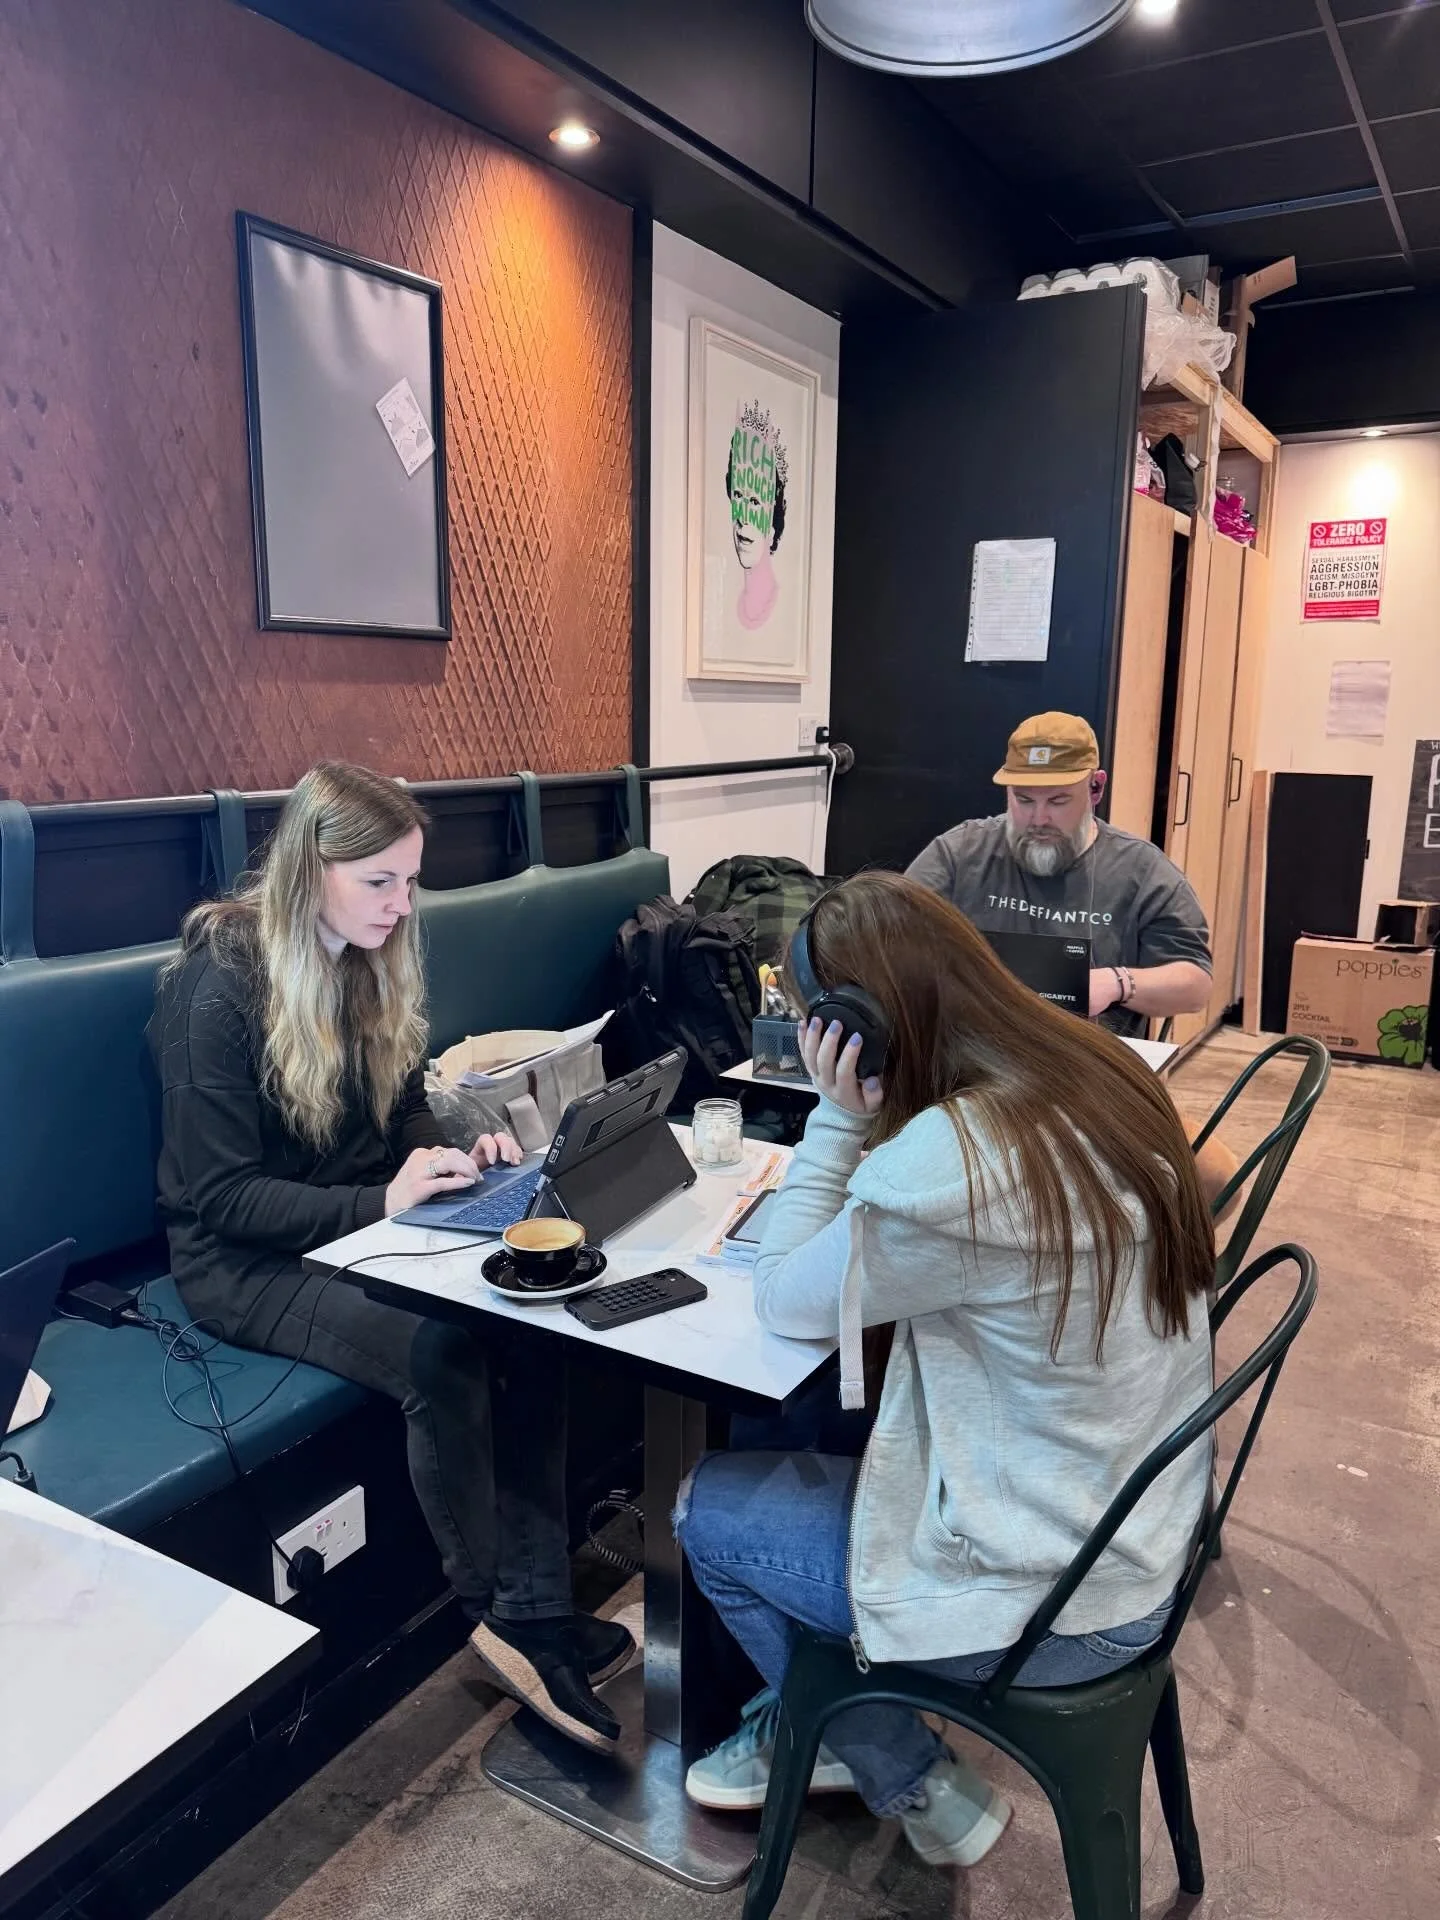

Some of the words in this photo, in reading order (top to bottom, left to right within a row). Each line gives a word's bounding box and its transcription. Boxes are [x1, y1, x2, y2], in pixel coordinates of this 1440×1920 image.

[734, 427, 774, 480] RICH
[731, 464, 774, 505] ENOUGH
[732, 499, 772, 535] BATMAN
[1330, 523, 1365, 537] ZERO
[1313, 536, 1354, 546] TOLERANCE
[1355, 535, 1382, 544] POLICY
[1337, 554, 1380, 562] HARASSMENT
[1311, 561, 1379, 574] AGGRESSION
[1309, 573, 1338, 581] RACISM
[1341, 571, 1379, 580] MISOGYNY
[1309, 579, 1378, 592] LGBT-PHOBIA
[1308, 591, 1345, 599] RELIGIOUS
[1347, 589, 1378, 597] BIGOTRY
[1336, 959, 1423, 980] poppies
[1039, 992, 1077, 1002] GIGABYTE
